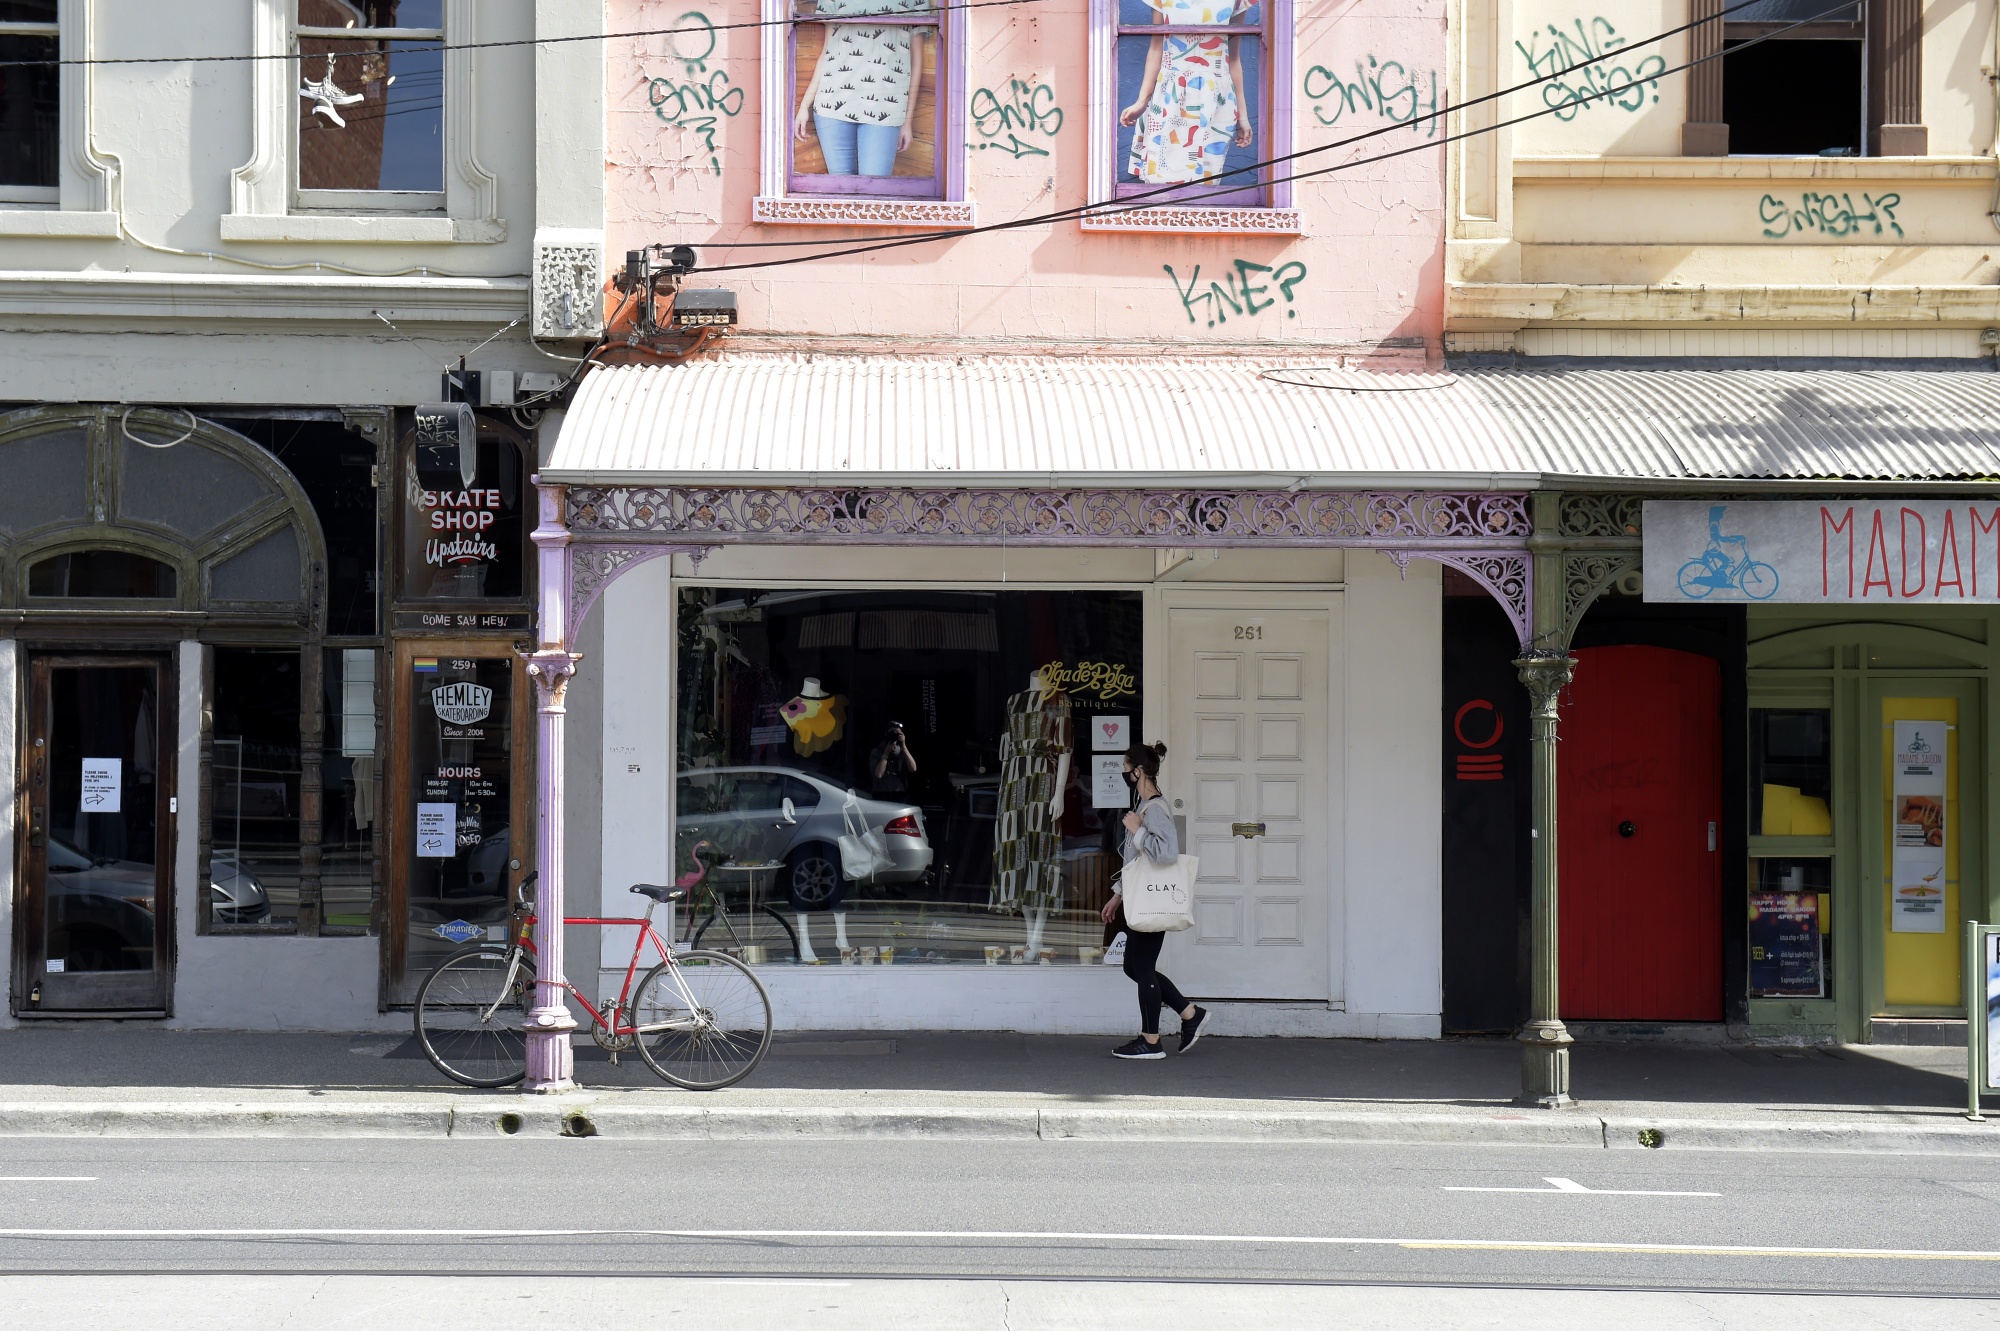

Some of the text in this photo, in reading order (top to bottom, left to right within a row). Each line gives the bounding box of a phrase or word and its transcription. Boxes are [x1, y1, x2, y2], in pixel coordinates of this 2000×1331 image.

[1163, 258, 1307, 328] KNE?
[423, 488, 501, 509] SKATE
[431, 511, 495, 531] SHOP
[425, 532, 498, 568] Upstairs
[422, 614, 509, 627] COME SAY HEY!
[1234, 625, 1262, 640] 261
[1072, 661, 1091, 682] de
[1087, 662, 1136, 699] Polga
[435, 684, 490, 706] HEMLEY
[1058, 700, 1117, 710] Boutique
[438, 707, 489, 722] SKATEBOARDING
[443, 726, 484, 736] Since 2004
[438, 767, 482, 778] HOURS
[456, 833, 482, 847] LOSED
[1146, 884, 1177, 892] CLAY
[439, 924, 479, 938] THRASHER
[1752, 946, 1765, 960] BEER
